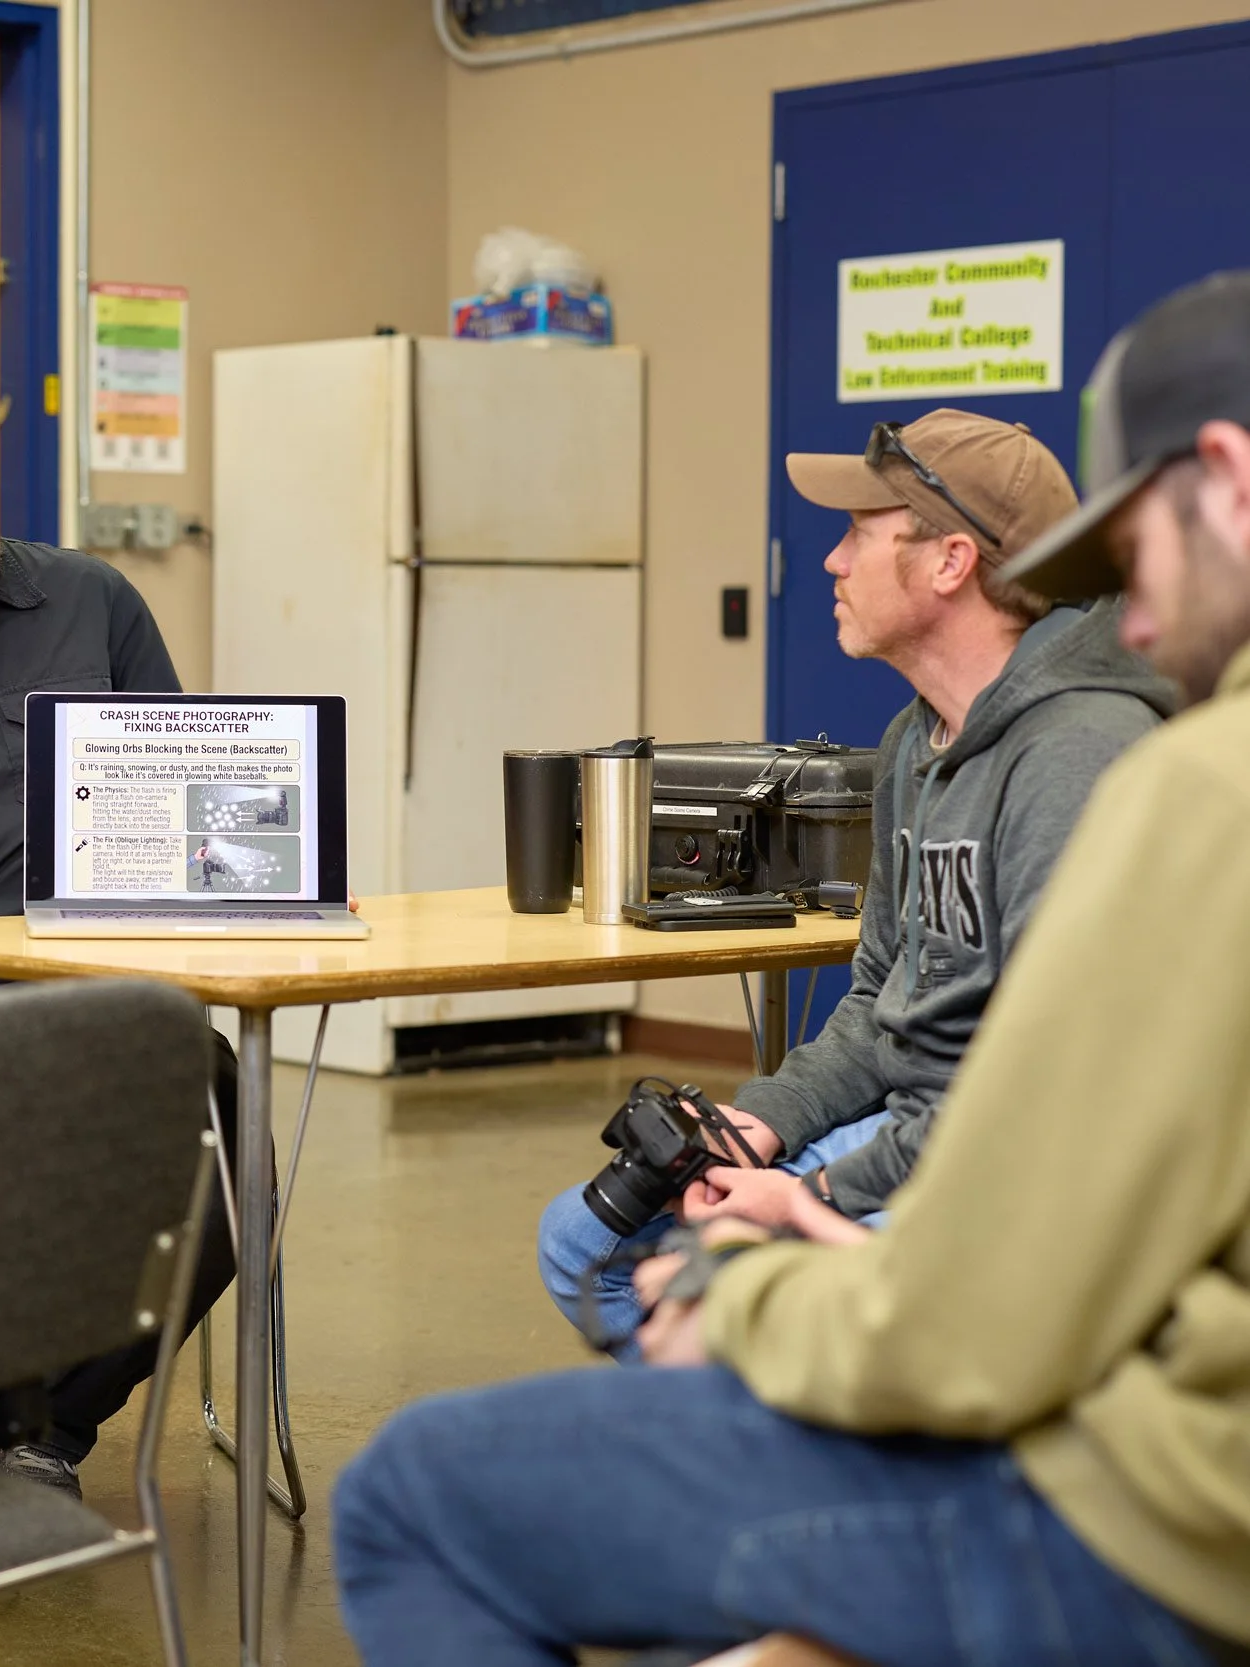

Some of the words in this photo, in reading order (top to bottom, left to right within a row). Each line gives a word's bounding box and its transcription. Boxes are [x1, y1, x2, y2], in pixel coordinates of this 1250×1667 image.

[850, 268, 938, 290] Rochester
[945, 256, 1049, 283] Community
[929, 296, 964, 318] And
[865, 329, 953, 354] Technical
[959, 325, 1031, 349] College
[879, 365, 976, 388] Enforcement
[982, 359, 1048, 383] Training
[100, 711, 139, 720] CRASH
[142, 711, 180, 721] SCENE
[183, 711, 274, 721] PHOTOGRAPHY:
[124, 723, 162, 732] FIXING
[165, 723, 249, 733] BACKSCATTER
[85, 743, 120, 754] Glowing
[122, 743, 142, 753] Orbs
[145, 744, 183, 755] Blocking
[185, 744, 199, 753] the
[201, 744, 227, 754] Scene
[230, 744, 288, 756] (Backscatter)
[79, 763, 87, 771] Q:
[88, 763, 99, 771] It's
[100, 763, 126, 772] raining,
[127, 764, 159, 773] snowing,
[168, 764, 189, 773] dusty,
[190, 764, 203, 772] and
[205, 764, 216, 772] the
[218, 764, 235, 772] flash
[236, 764, 259, 772] makes
[273, 765, 293, 773] photo
[104, 771, 120, 779] look
[121, 771, 134, 779] like
[184, 772, 211, 781] glowing
[213, 772, 232, 780] white
[234, 772, 269, 780] baseballs.
[105, 786, 128, 794] Physics:
[162, 787, 177, 795] firing
[115, 836, 139, 844] (Oblique
[140, 836, 168, 844] Lighting):
